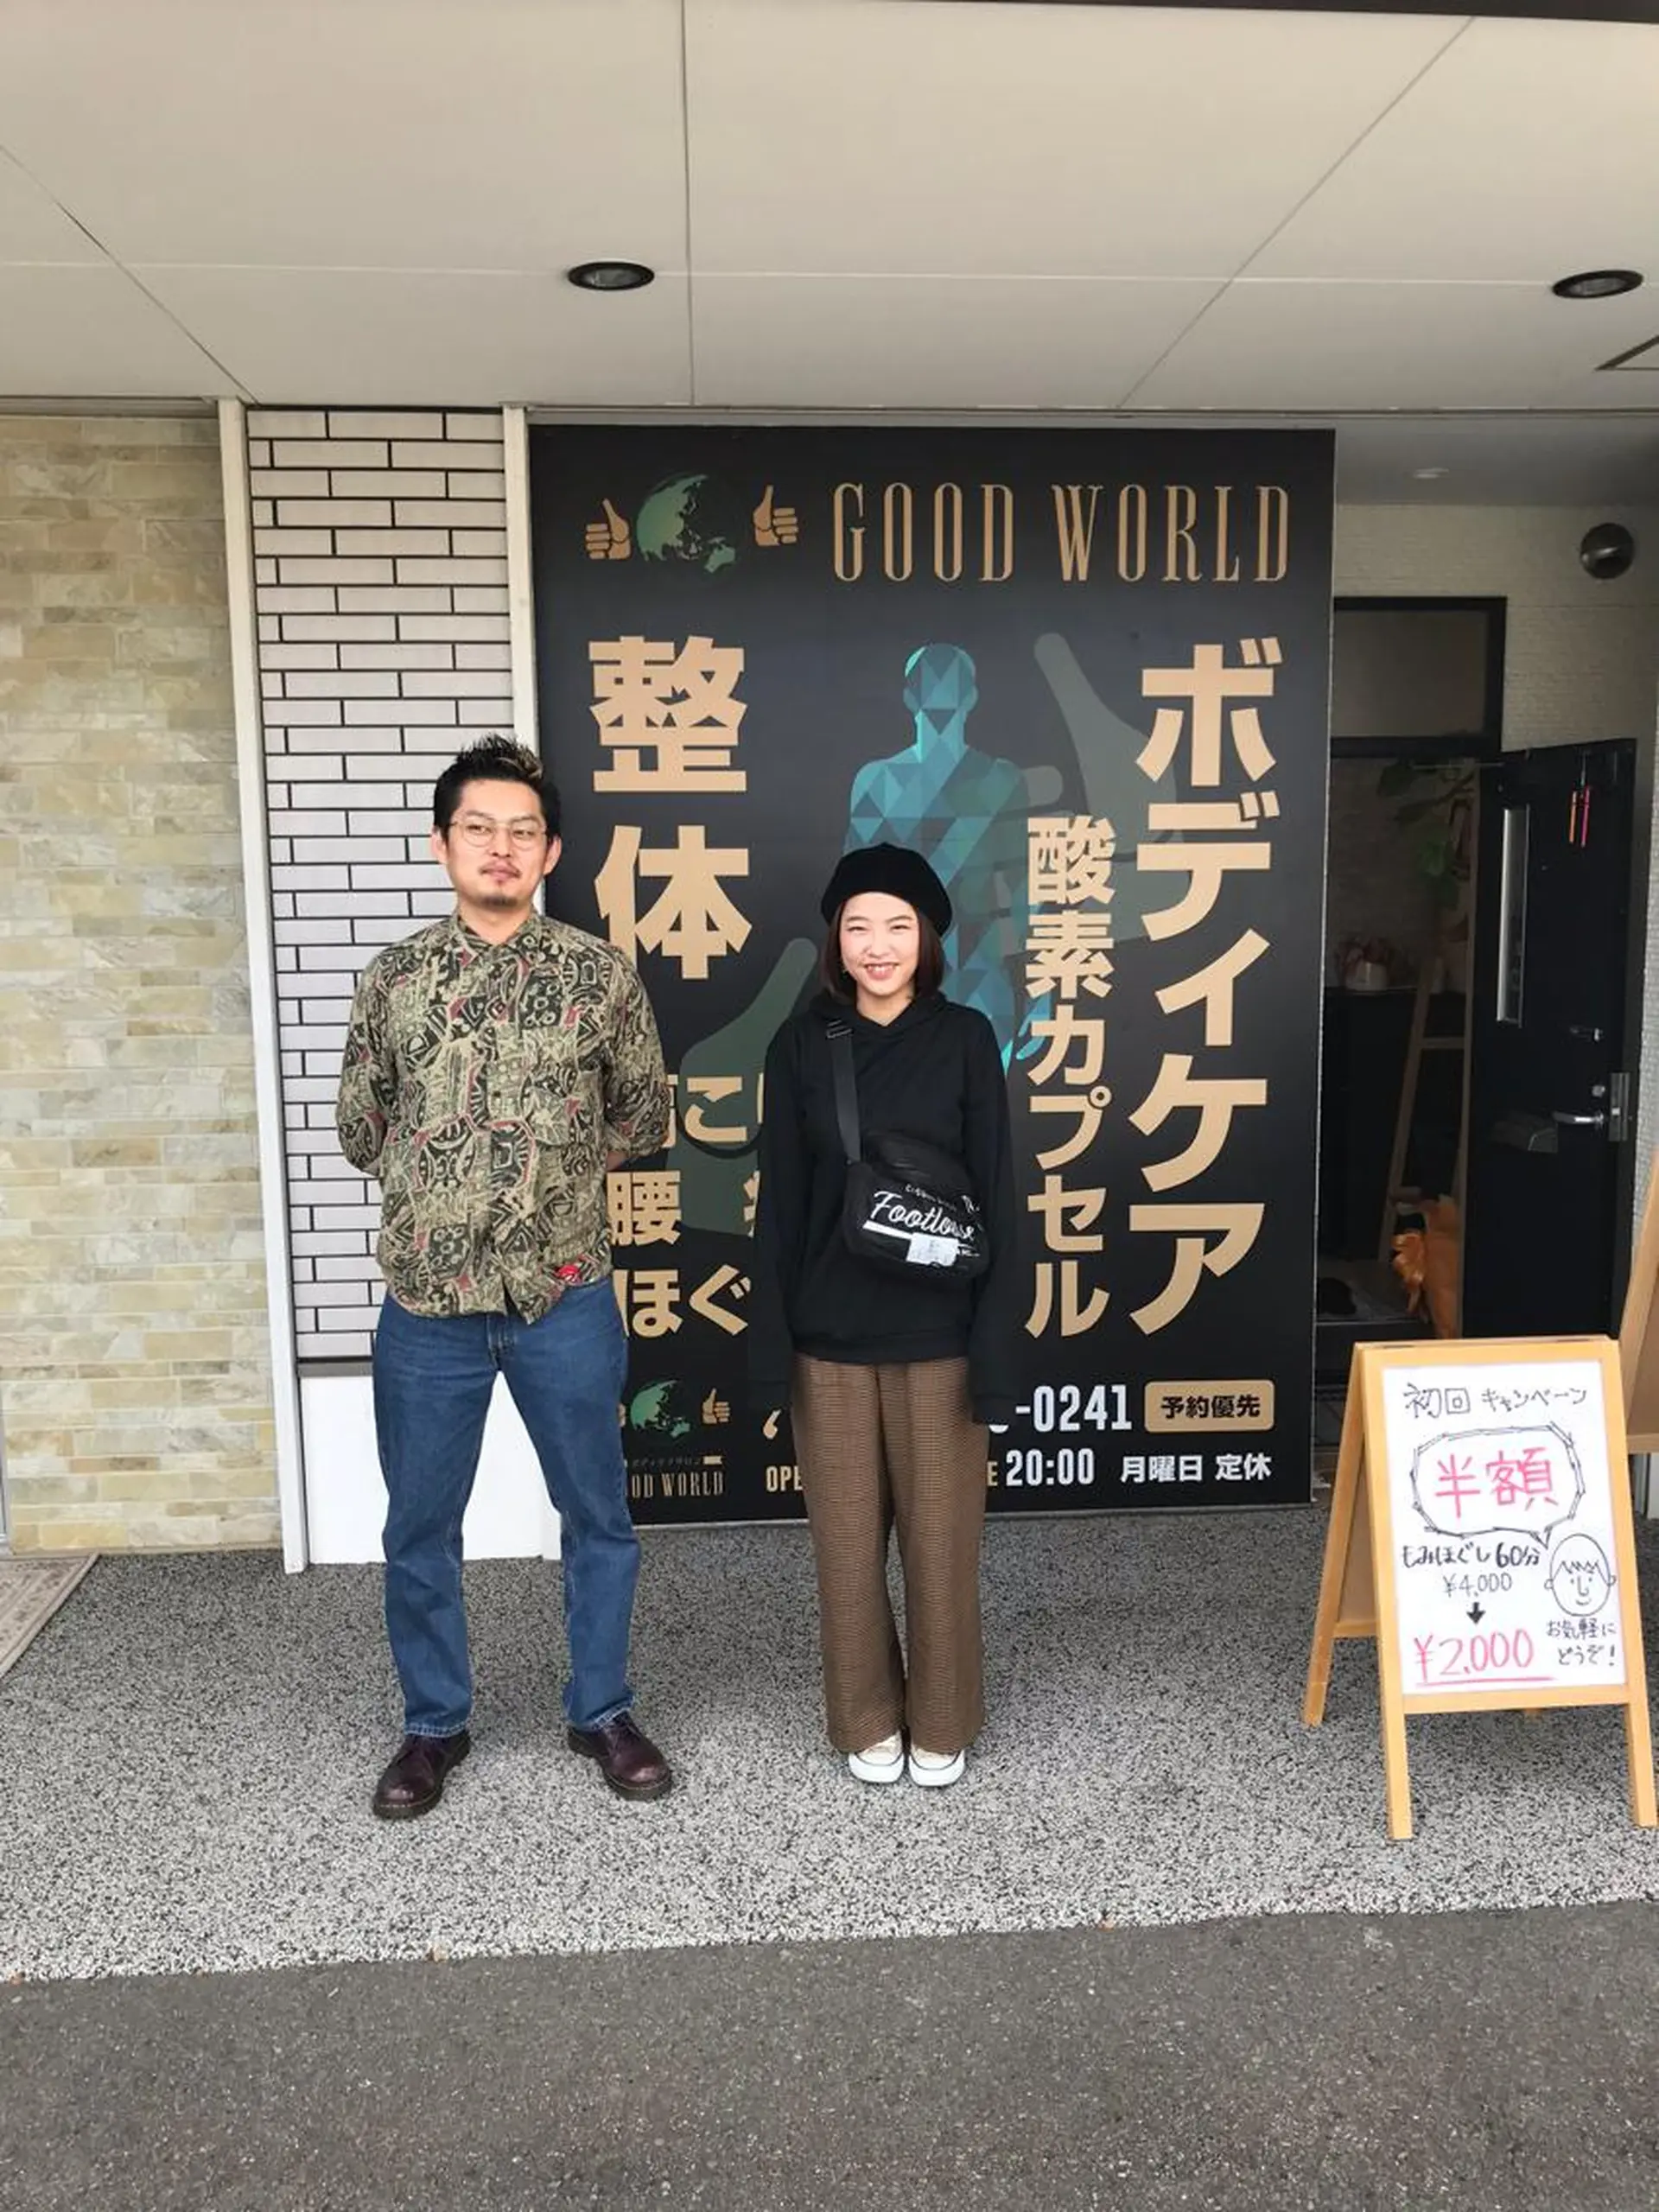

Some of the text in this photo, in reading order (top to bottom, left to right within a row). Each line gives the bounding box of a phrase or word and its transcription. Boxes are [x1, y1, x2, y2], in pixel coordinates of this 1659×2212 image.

[833, 481, 1290, 583] GOOD WORLD
[589, 634, 753, 979] 整体
[1128, 637, 1283, 1336] ボディケア
[1025, 816, 1116, 1338] 酸素カプセル
[1160, 1394, 1261, 1420] 予約優先
[1402, 1382, 1471, 1418] 初回
[661, 1471, 724, 1497] WORLD
[1005, 1448, 1095, 1486] 20:00
[1120, 1452, 1272, 1483] 月曜日 定休
[1434, 1446, 1559, 1519] 半額
[1545, 1619, 1618, 1642] お気軽に
